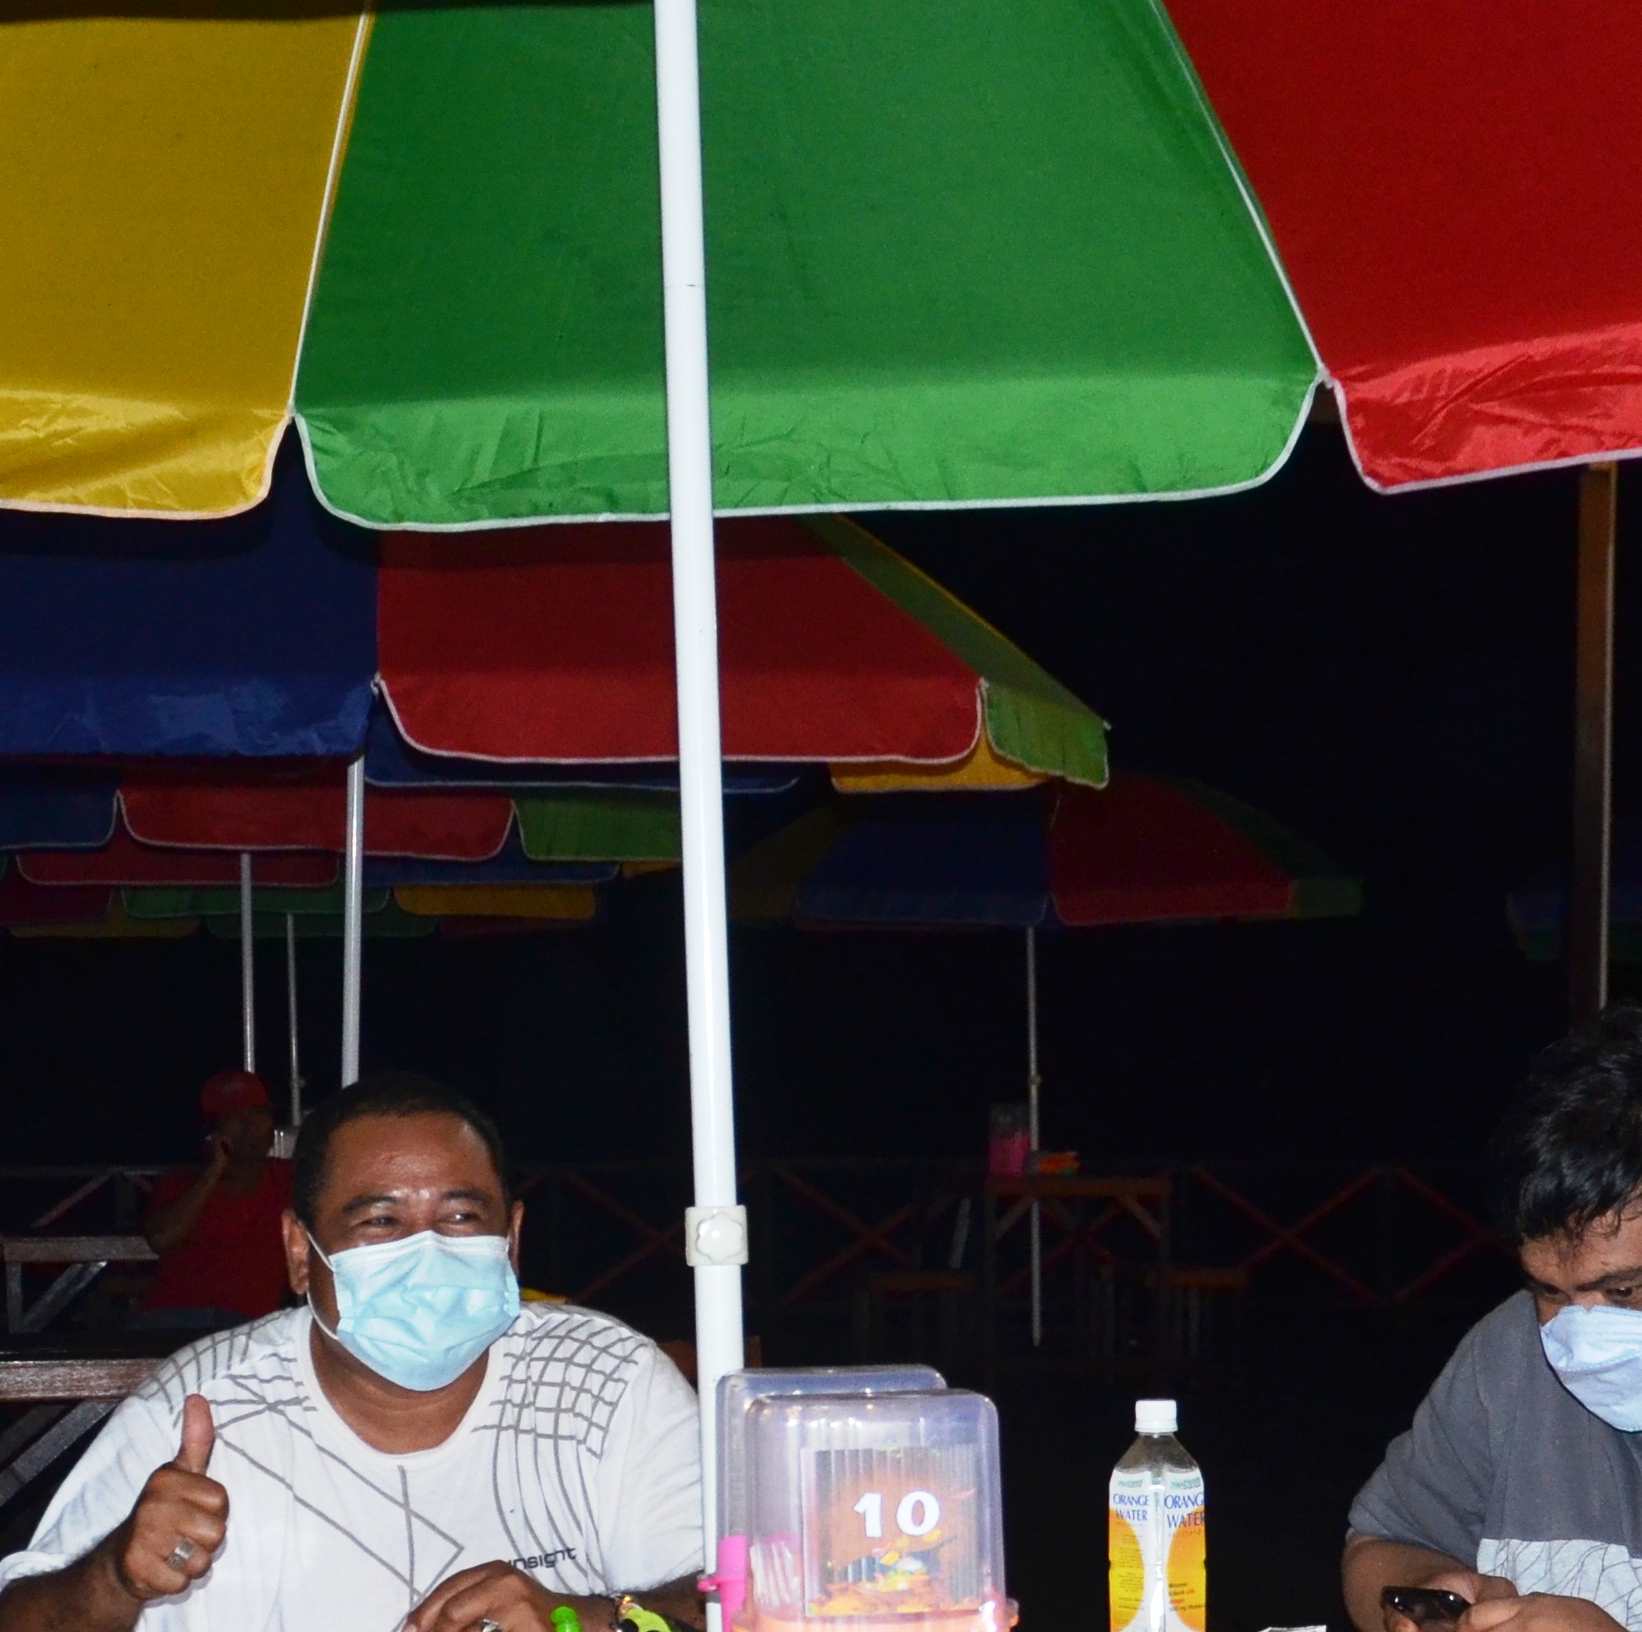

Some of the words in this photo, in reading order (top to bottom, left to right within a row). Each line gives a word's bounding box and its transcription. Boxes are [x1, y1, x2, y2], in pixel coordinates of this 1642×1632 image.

[1113, 1493, 1150, 1507] ORANGE
[853, 1490, 942, 1538] 10
[1116, 1508, 1148, 1521] WATER
